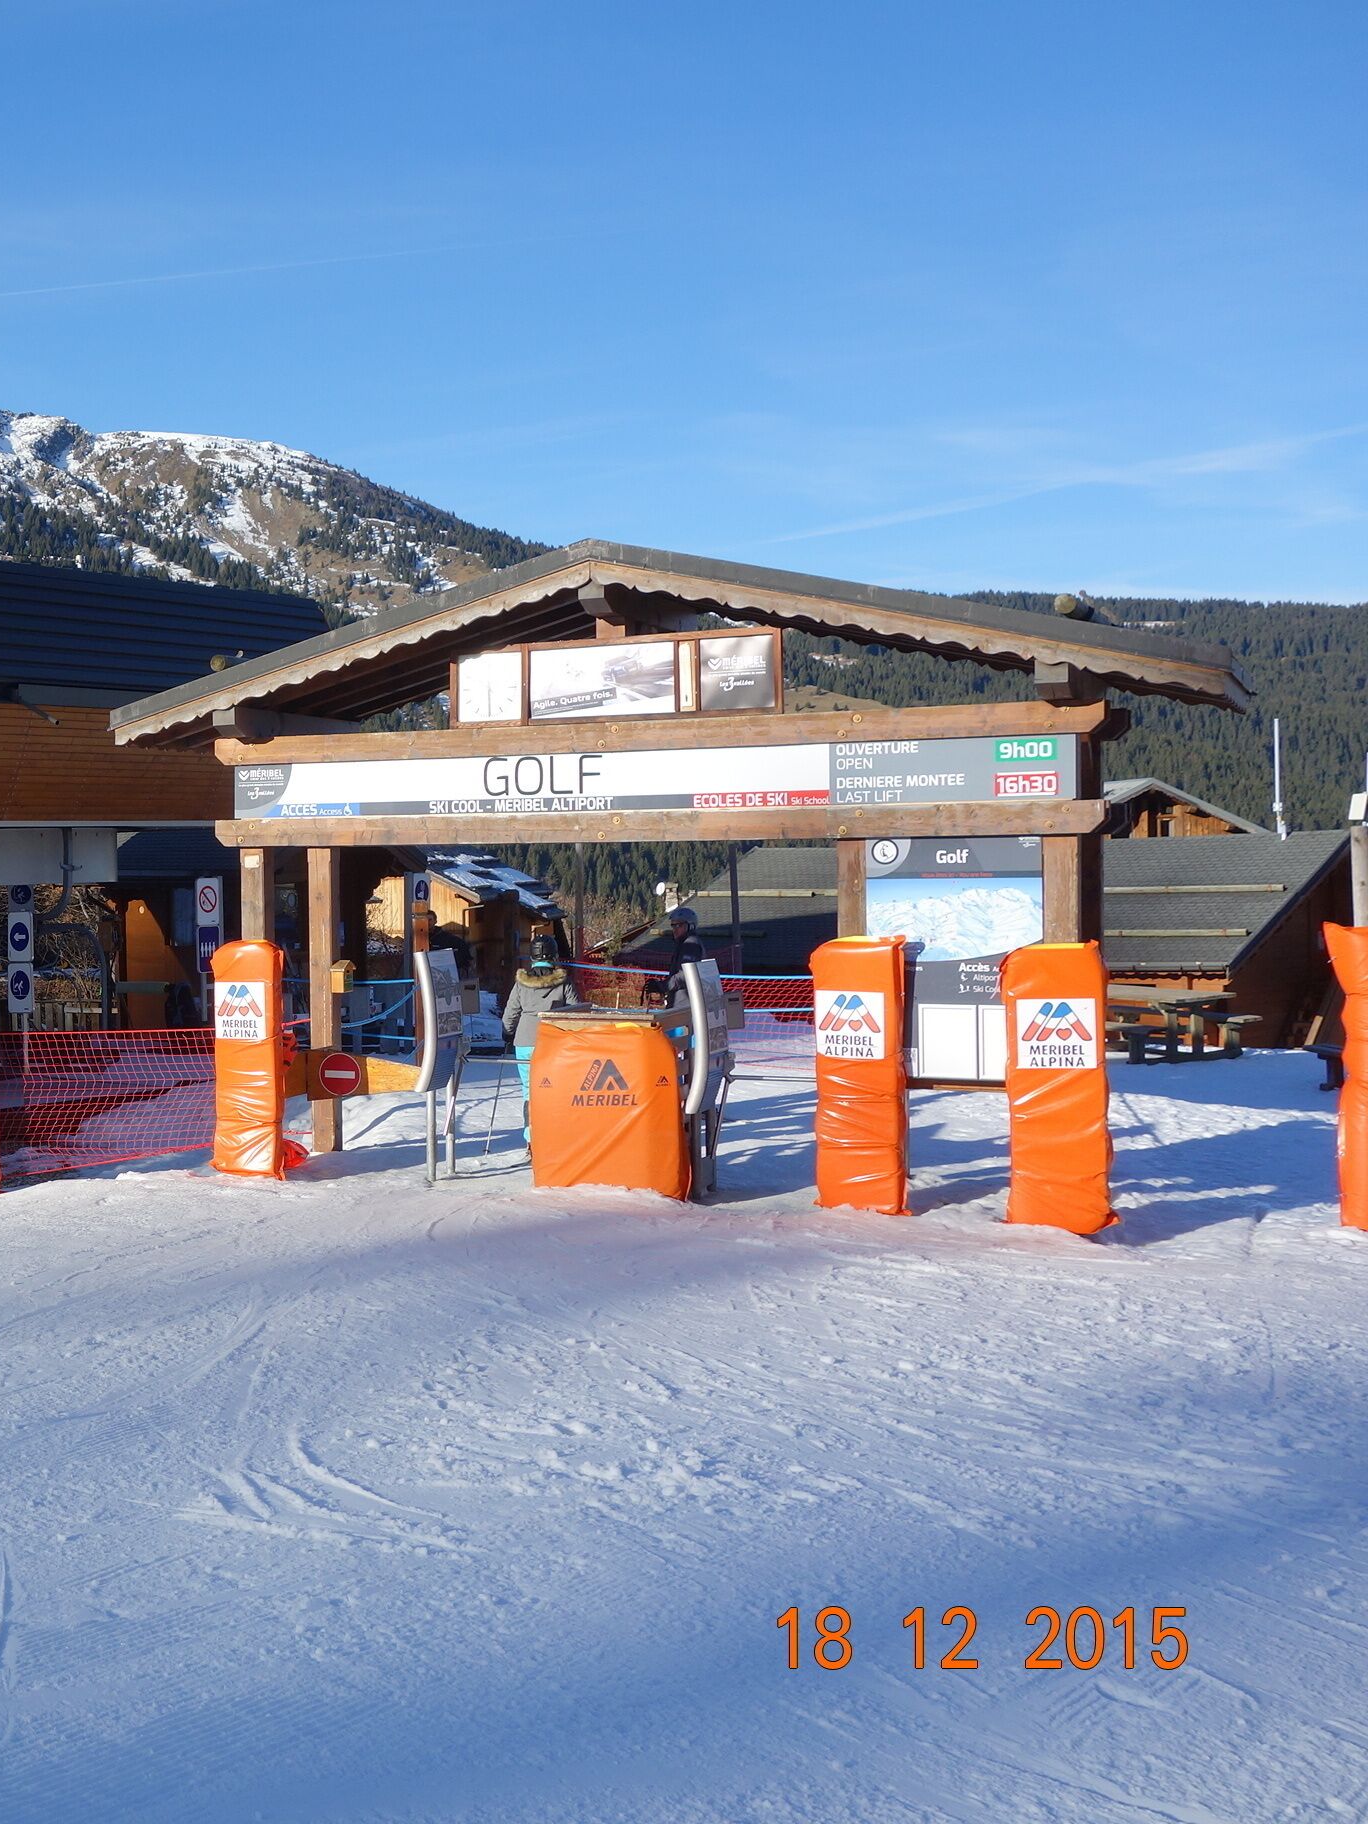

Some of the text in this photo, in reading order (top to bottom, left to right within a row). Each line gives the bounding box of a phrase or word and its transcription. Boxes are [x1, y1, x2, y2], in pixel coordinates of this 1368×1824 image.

[533, 700, 558, 710] Agile.
[560, 694, 591, 706] Quatre
[593, 690, 613, 700] fois.
[835, 742, 919, 756] OUVERTURE
[999, 741, 1052, 758] 9h00
[836, 758, 873, 770] OPEN
[483, 755, 603, 797] GOLF
[836, 773, 966, 789] DERNIERE MONTEE
[996, 775, 1057, 793] 16h30
[693, 792, 830, 808] ECOLES DE SKI Ski School
[836, 789, 903, 804] LAST LIFT
[280, 804, 343, 817] ACCES Access
[429, 801, 449, 814] SKI
[451, 800, 483, 813] COOL
[494, 799, 548, 812] MERIBEL
[551, 797, 614, 811] ALTIPORT
[935, 848, 969, 864] Golf
[958, 962, 991, 972] Accès
[222, 1019, 258, 1028] MERIBEL
[222, 1029, 258, 1038] ALPINA
[825, 1034, 874, 1046] MERIBEL
[825, 1046, 874, 1057] ALPINA
[1029, 1044, 1085, 1055] MERIBEL
[1029, 1056, 1085, 1067] ALPINA
[583, 1063, 601, 1090] ALPINA
[571, 1094, 639, 1106] MERIBEL
